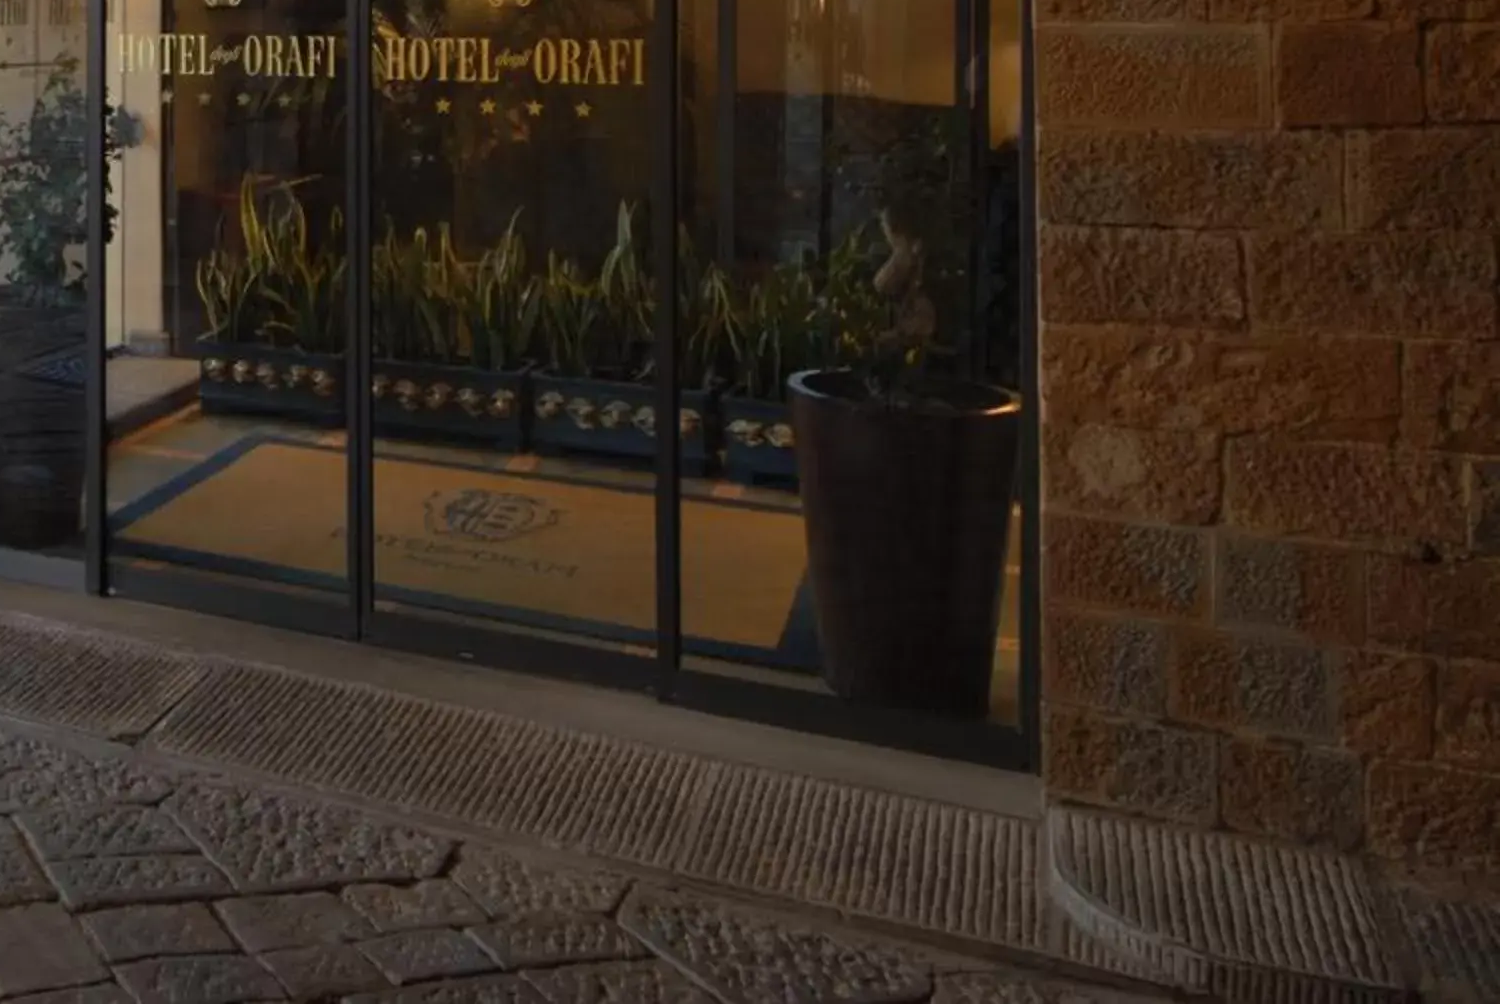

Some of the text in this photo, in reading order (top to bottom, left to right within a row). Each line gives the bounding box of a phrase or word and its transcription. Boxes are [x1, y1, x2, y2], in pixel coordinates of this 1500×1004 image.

[117, 34, 214, 76] HOTEL
[243, 35, 336, 78] ORAFI
[384, 38, 499, 82] HOTEL
[533, 38, 644, 85] ORAFI
